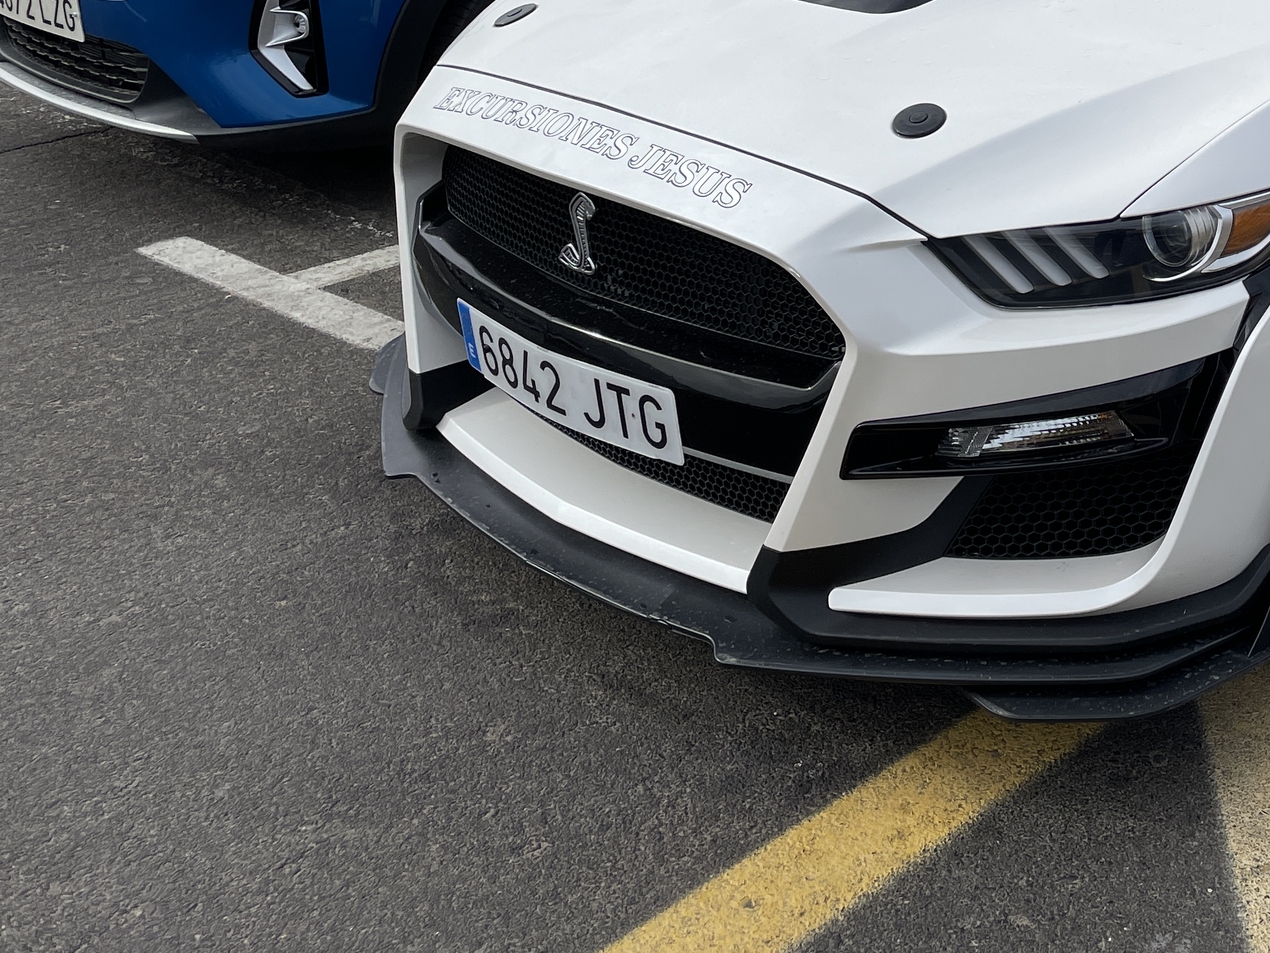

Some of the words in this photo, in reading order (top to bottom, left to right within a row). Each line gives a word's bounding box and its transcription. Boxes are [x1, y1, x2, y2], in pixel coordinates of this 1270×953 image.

[433, 86, 638, 161] EXCURSIONES
[627, 143, 753, 209] JESUS
[468, 342, 477, 359] E
[479, 325, 567, 417] 6842
[583, 377, 669, 450] JTG
